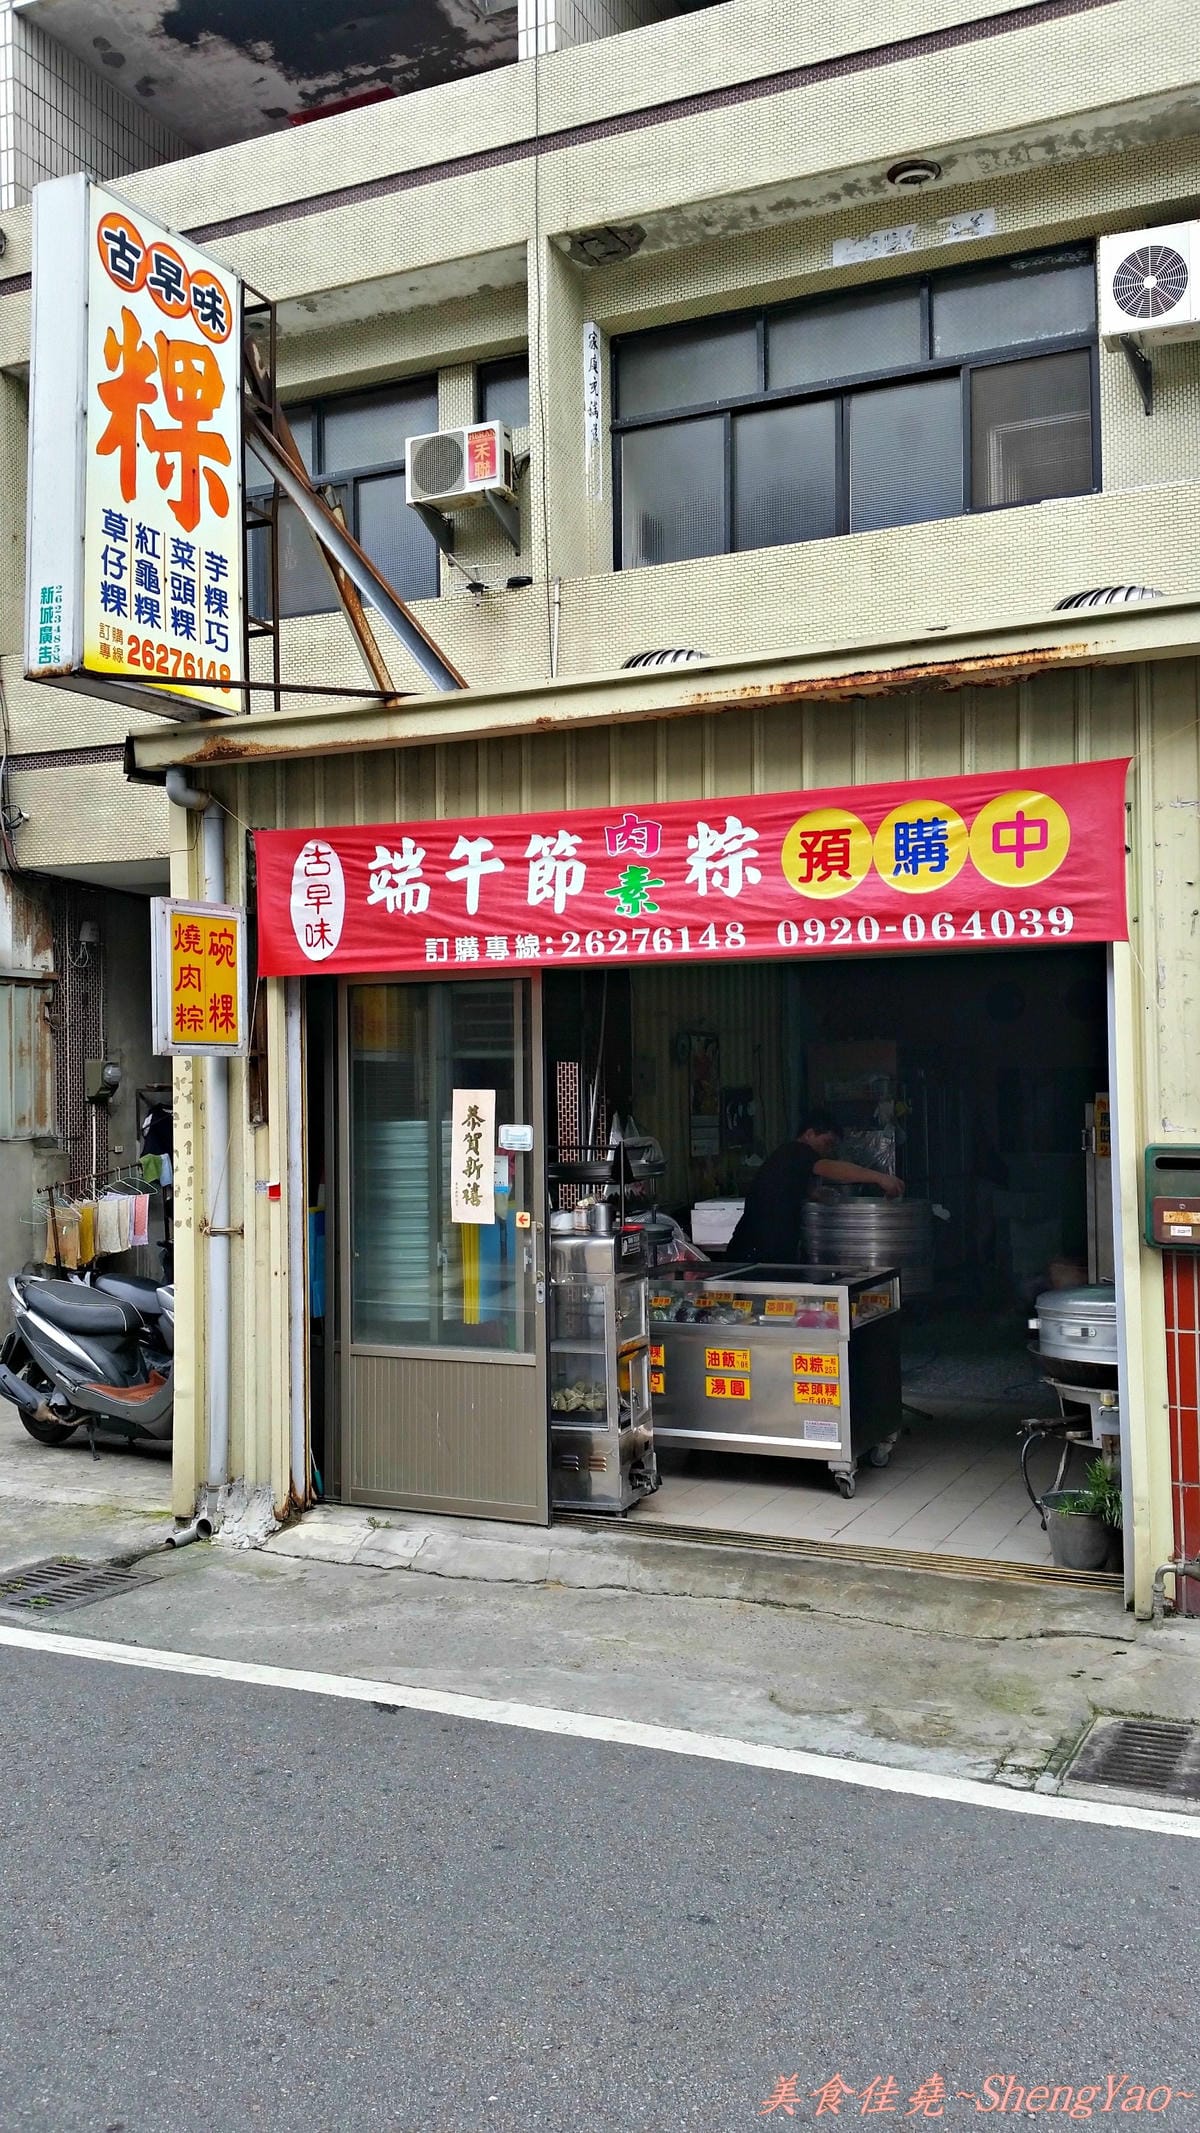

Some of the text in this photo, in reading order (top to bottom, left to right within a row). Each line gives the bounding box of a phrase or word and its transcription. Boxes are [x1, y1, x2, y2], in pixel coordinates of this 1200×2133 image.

[100, 226, 228, 335] 古早味
[96, 305, 233, 534] 粿
[100, 507, 129, 619] 草仔粿
[134, 521, 162, 630] 紅龜粿
[169, 536, 197, 642] 菜頭粿
[204, 550, 229, 653] 芋粿巧
[38, 585, 54, 665] 新城廣告
[127, 634, 231, 694] 26276148
[366, 828, 587, 916] 端午節
[604, 812, 663, 859] 肉
[684, 815, 762, 898] 粽
[798, 810, 1049, 884] 預購中
[302, 844, 334, 950] 古早味
[604, 865, 666, 918] 素
[776, 905, 1075, 948] 0920-064039
[174, 922, 204, 1033] 燒肉粽
[208, 927, 236, 1034] 碗粿
[461, 1104, 486, 1207] 恭賀新禧
[707, 1350, 736, 1368] 油飯
[711, 1378, 745, 1396] 湯圓
[795, 1355, 824, 1373] 肉粽
